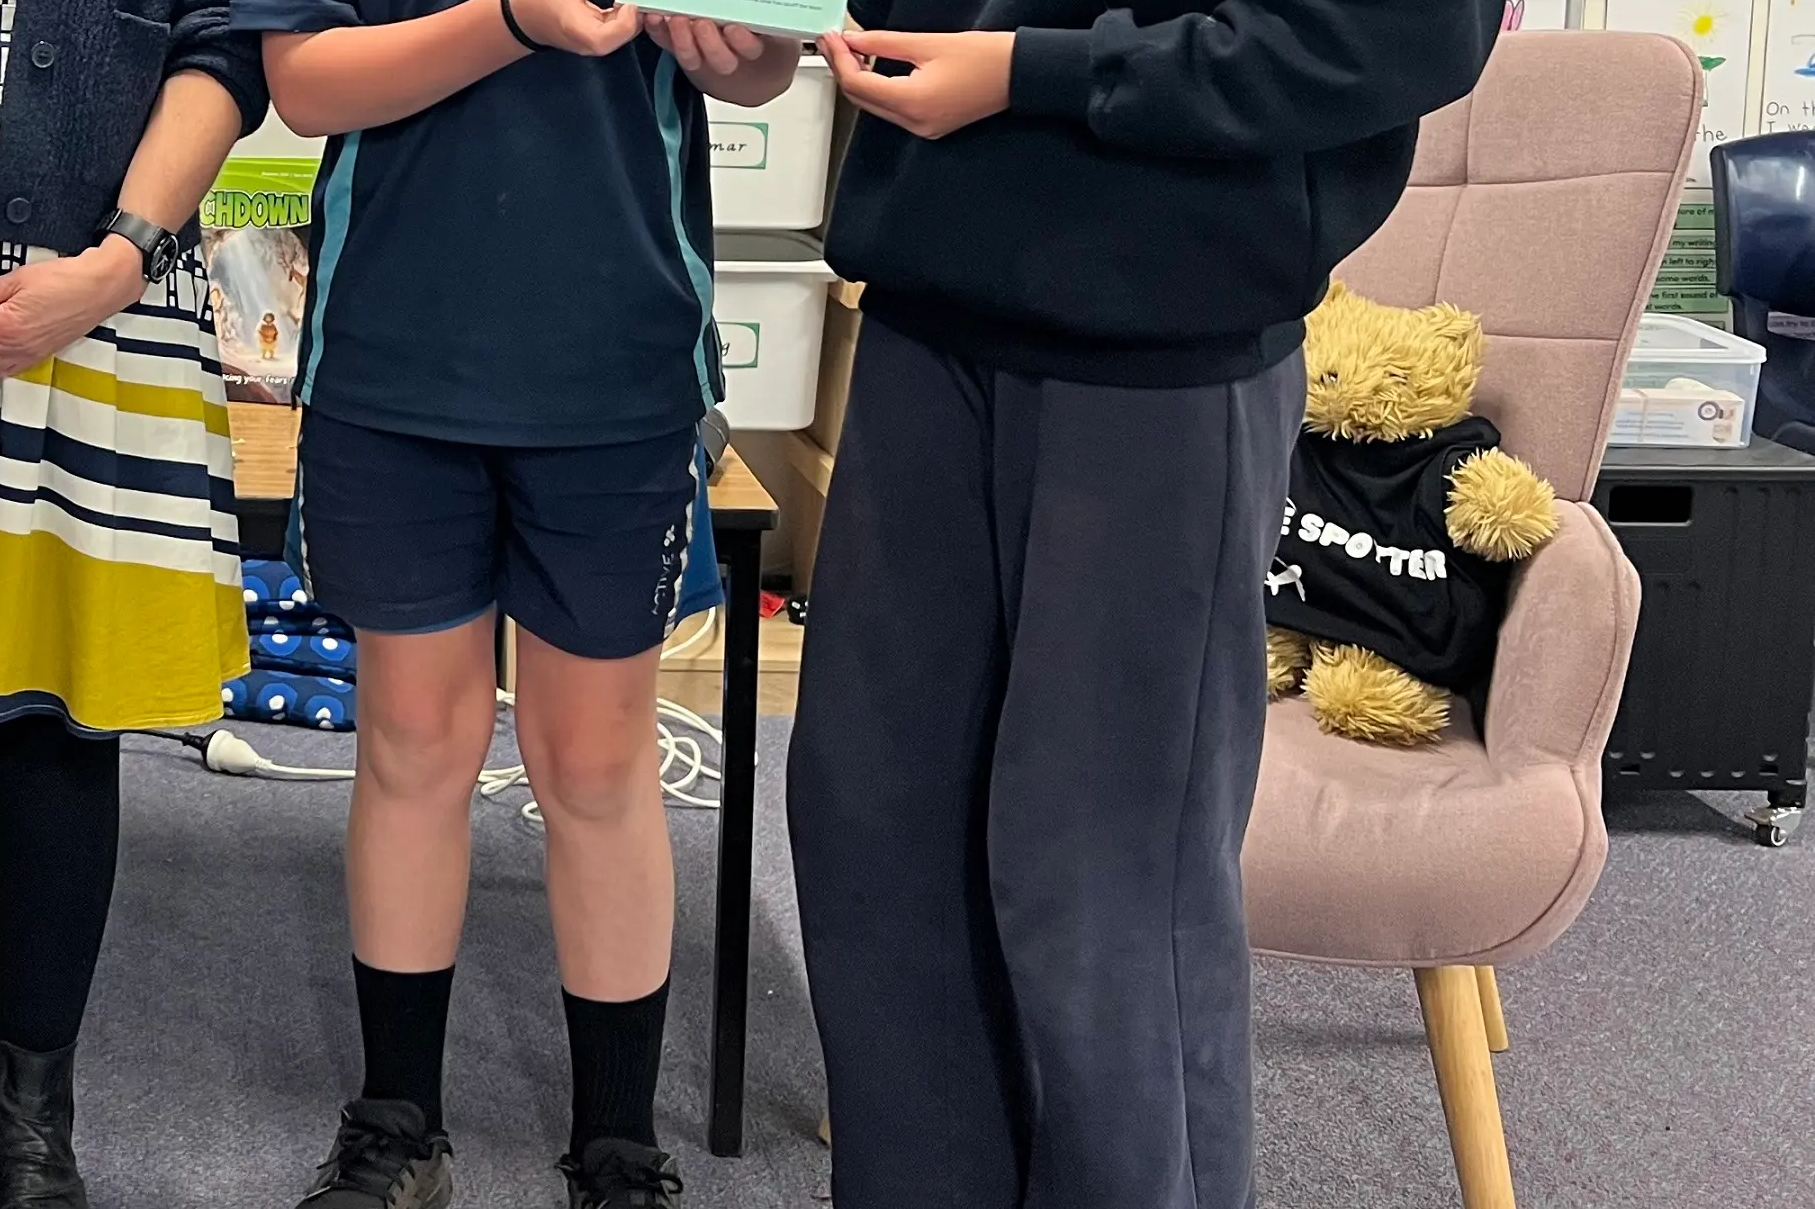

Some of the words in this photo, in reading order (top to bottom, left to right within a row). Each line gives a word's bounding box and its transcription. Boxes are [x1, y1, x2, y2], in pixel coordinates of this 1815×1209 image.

[1766, 101, 1790, 116] On
[200, 191, 310, 228] CHDOWN
[1298, 513, 1448, 581] SPOTTER
